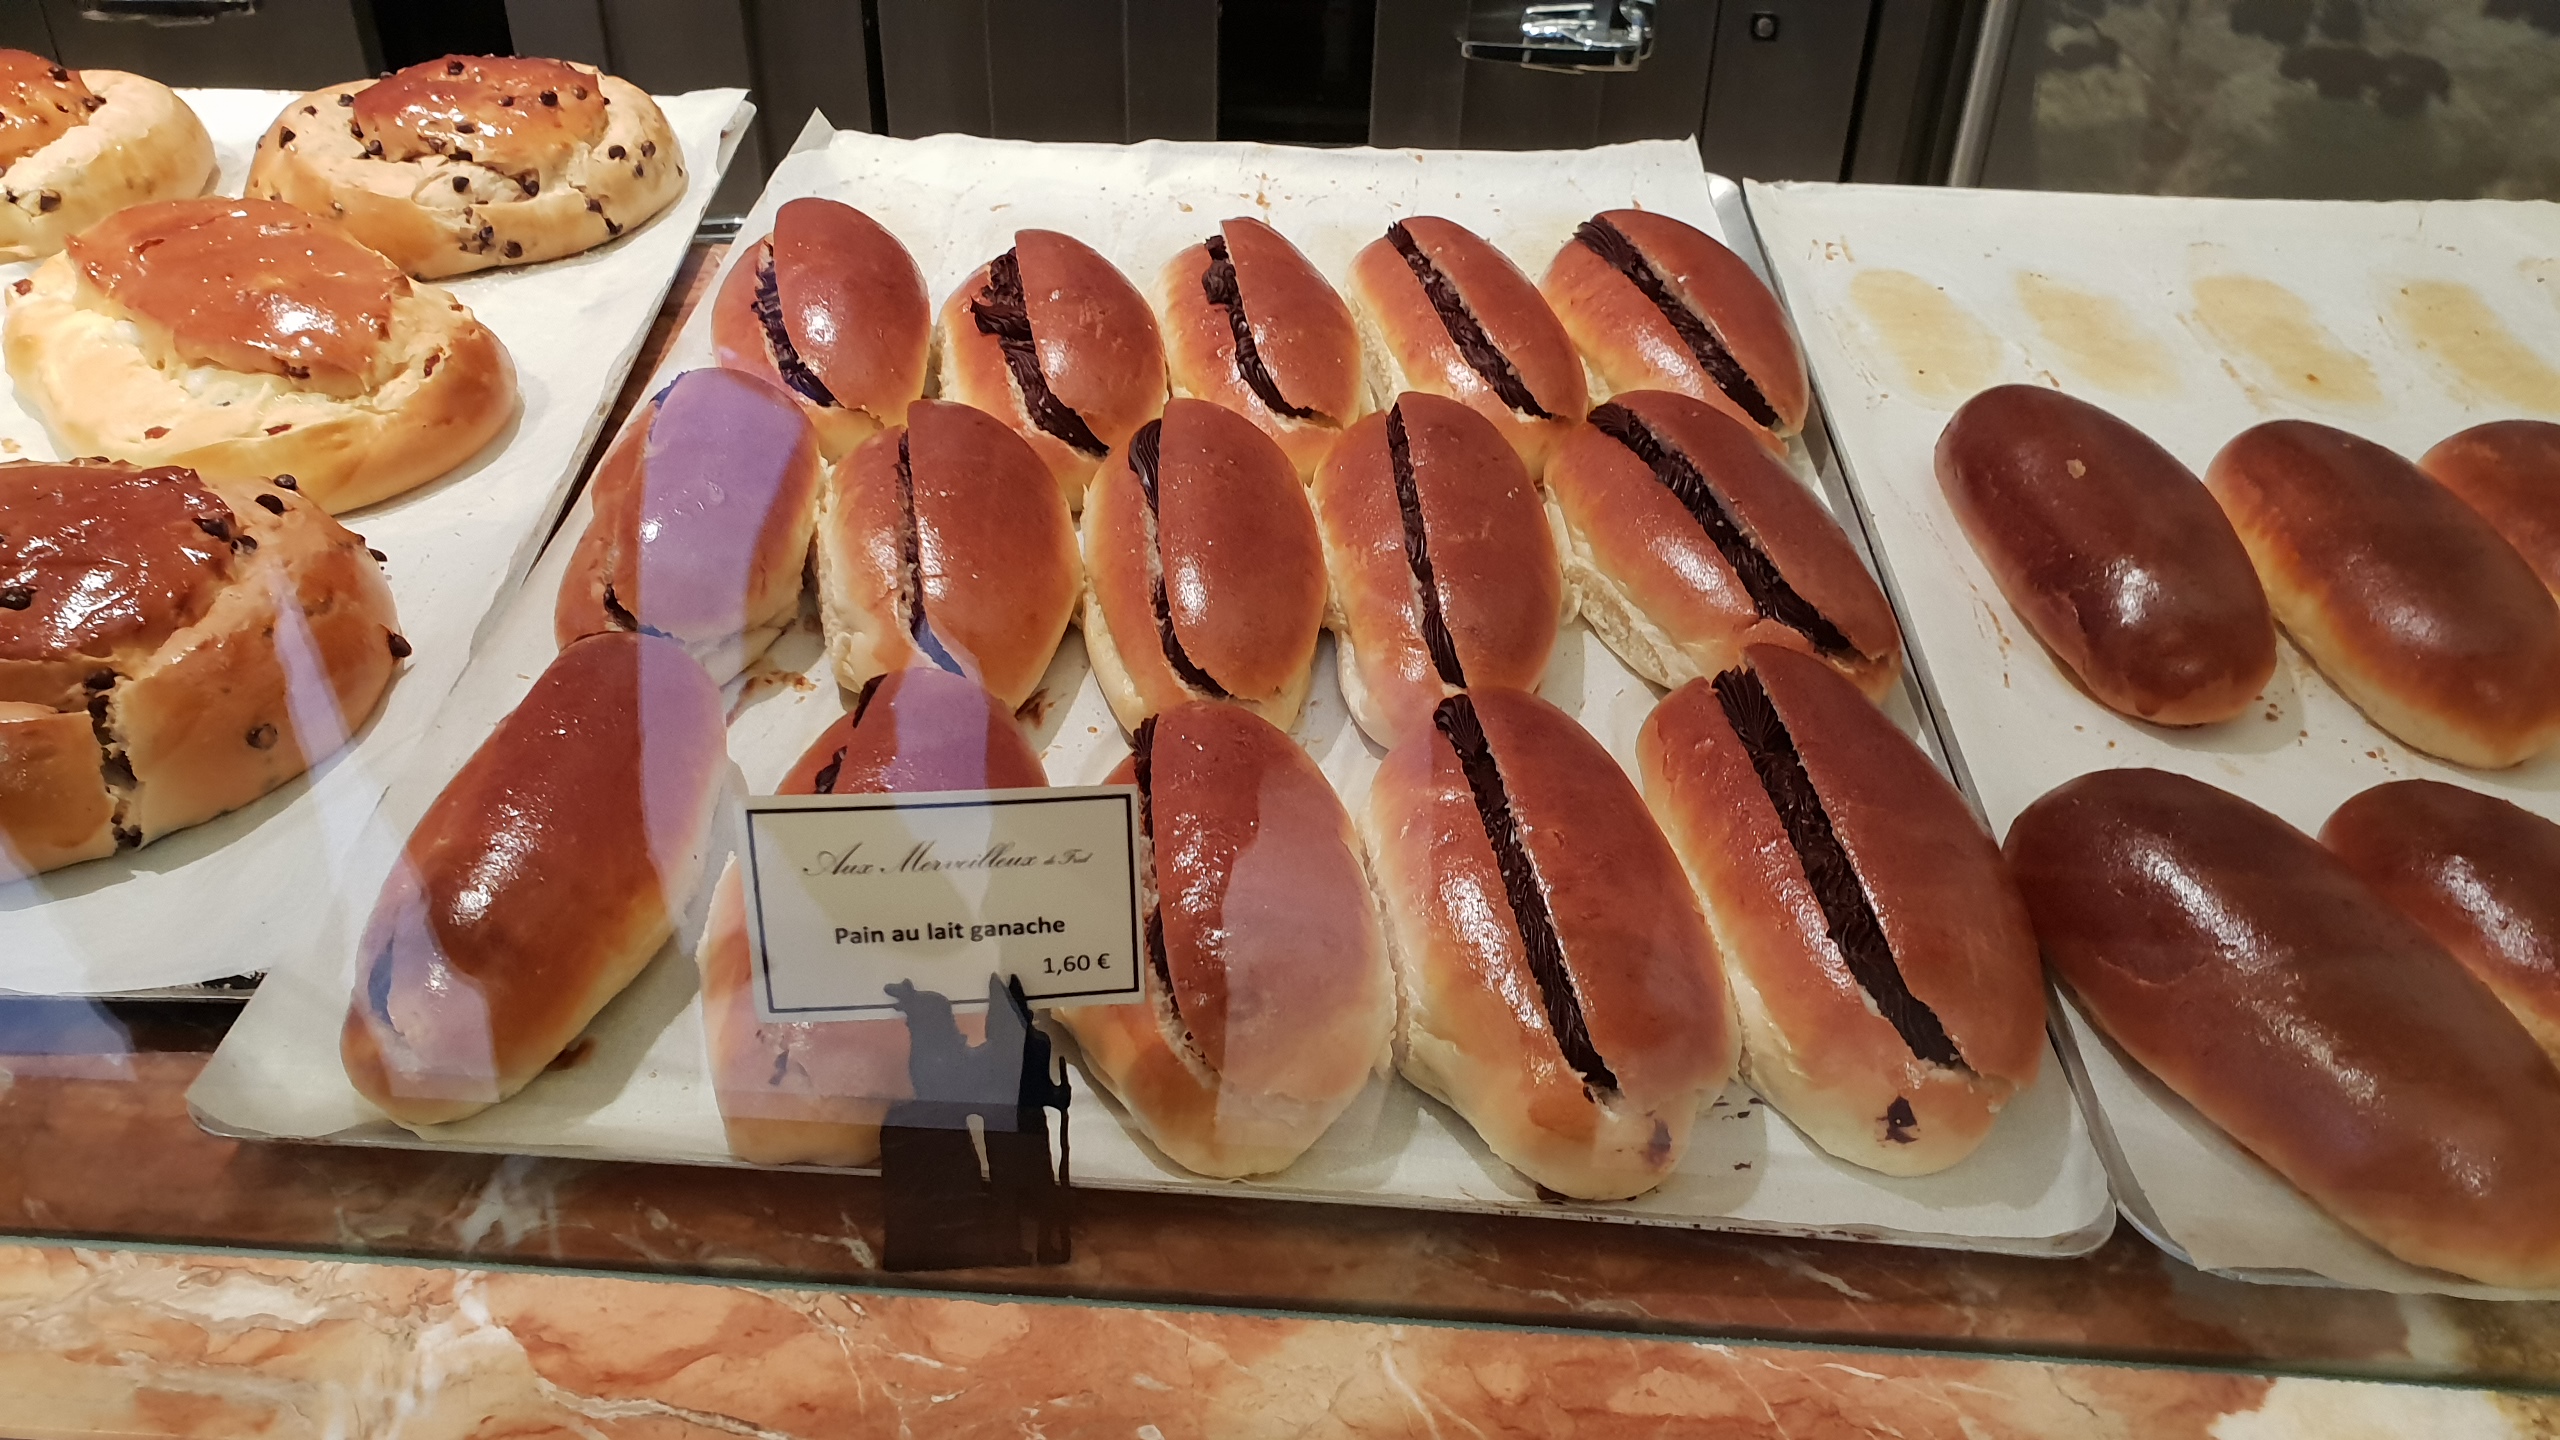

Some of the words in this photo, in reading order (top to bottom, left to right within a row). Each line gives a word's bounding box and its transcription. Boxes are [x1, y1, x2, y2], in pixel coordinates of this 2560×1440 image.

[803, 842, 873, 876] Aux
[881, 841, 1037, 873] Merveilleux
[834, 925, 885, 945] Pain
[892, 926, 920, 943] au
[927, 921, 965, 941] lait
[970, 916, 1066, 943] ganache
[1043, 954, 1091, 977] 1,60
[1097, 952, 1111, 970] €
